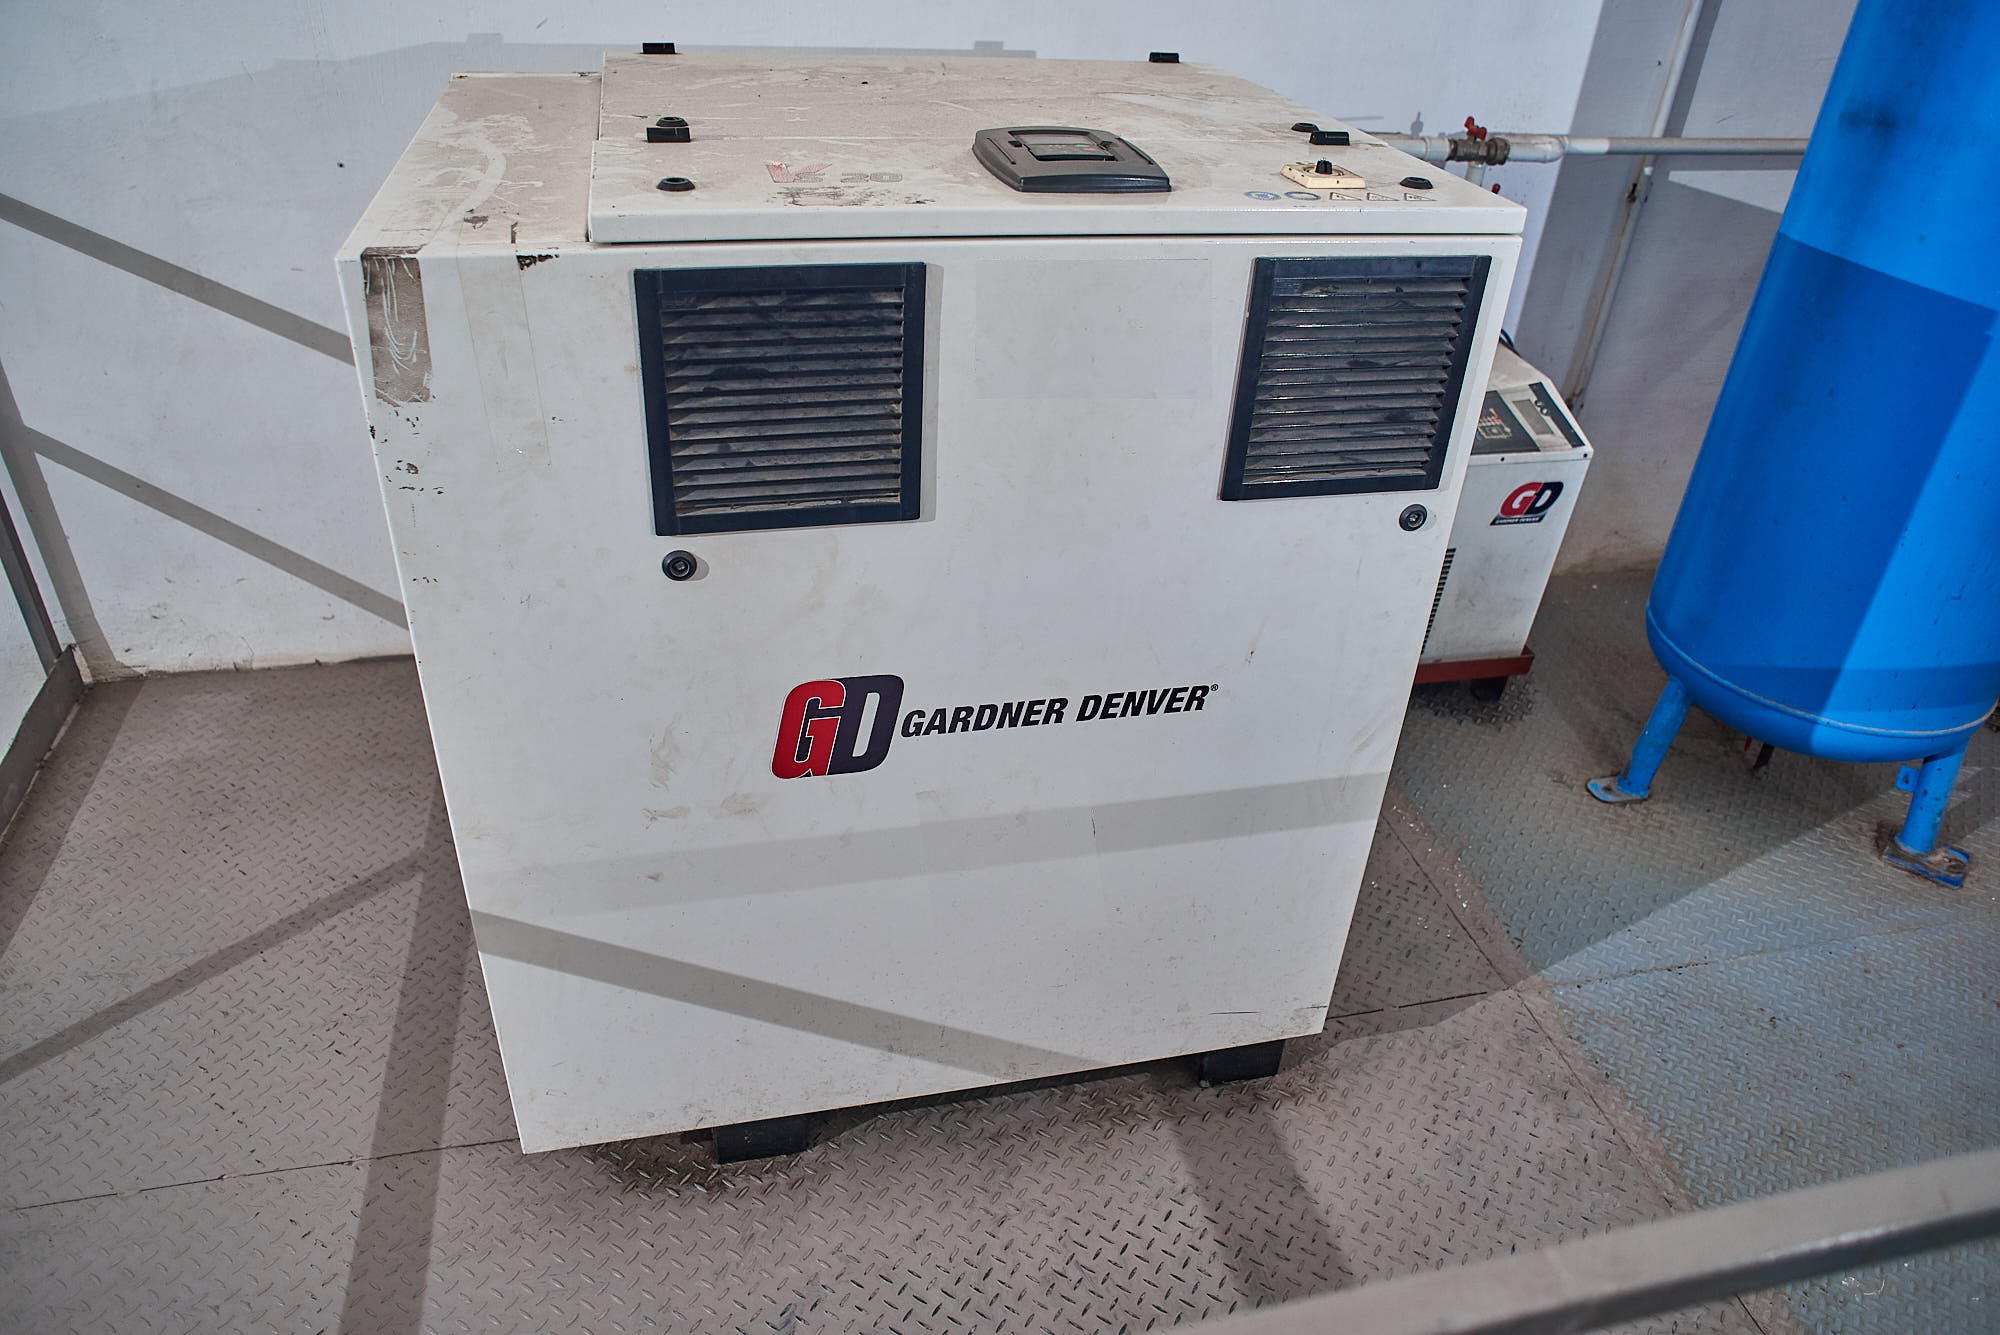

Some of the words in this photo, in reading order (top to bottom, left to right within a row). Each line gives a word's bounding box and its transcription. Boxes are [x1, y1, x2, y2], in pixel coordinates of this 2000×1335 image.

[840, 172, 903, 183] 20
[1500, 481, 1564, 517] GD
[771, 674, 904, 779] GD
[901, 697, 1069, 738] GARDNER
